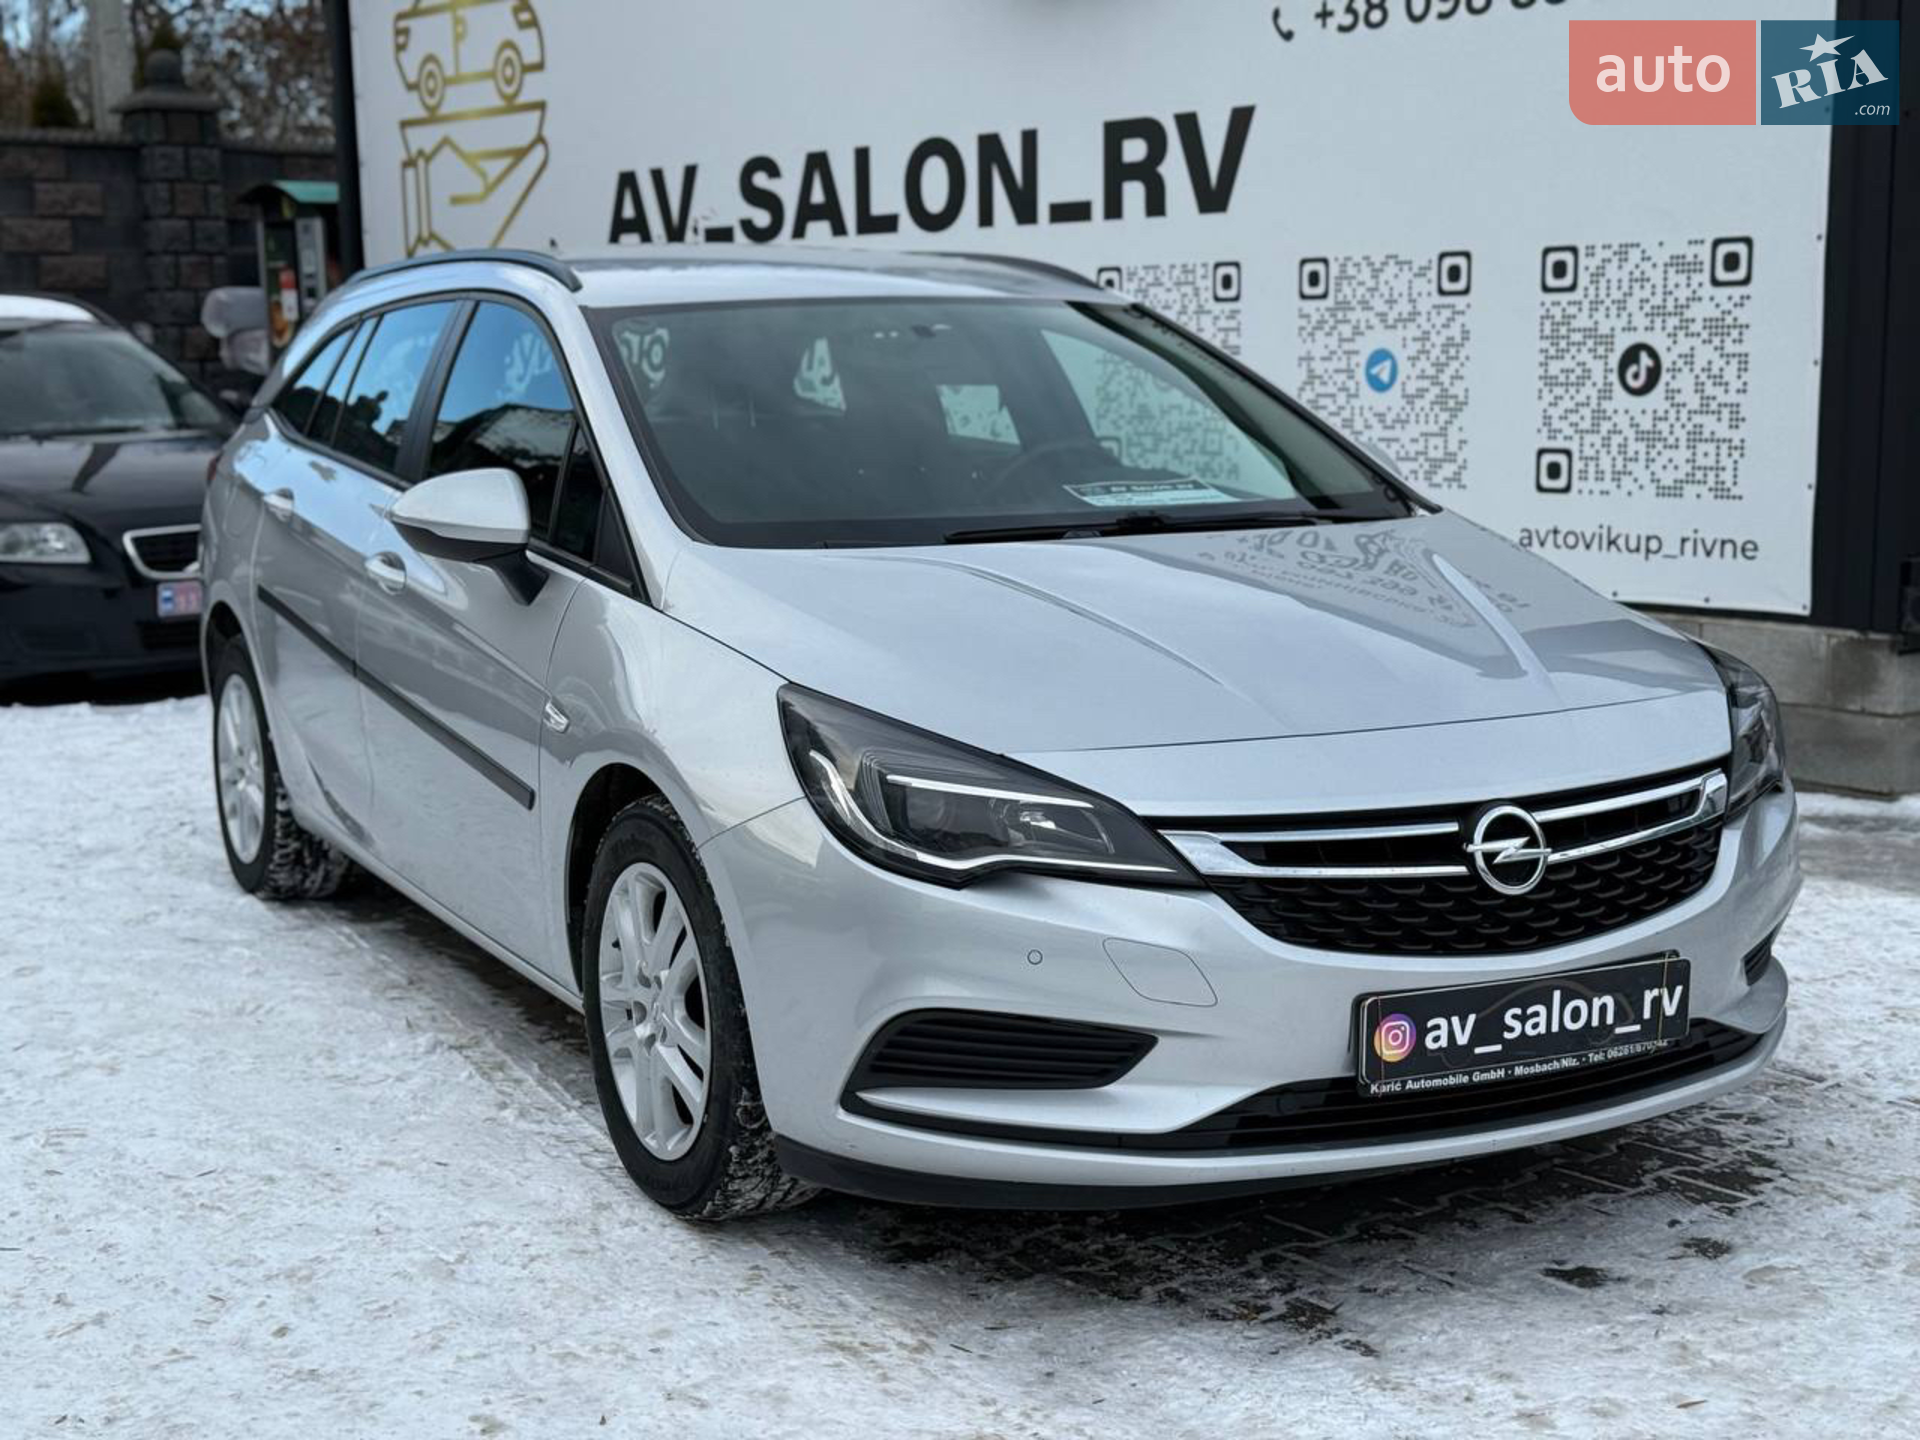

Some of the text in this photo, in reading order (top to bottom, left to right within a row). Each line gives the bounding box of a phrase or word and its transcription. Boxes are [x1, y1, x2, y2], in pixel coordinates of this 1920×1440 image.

[608, 104, 1256, 244] AV_SALON_RV
[1518, 524, 1760, 561] avtovikup_rivne
[1424, 984, 1683, 1054] av_salon_rv
[1405, 1072, 1470, 1091] Automobile
[1472, 1067, 1506, 1083] GmbH
